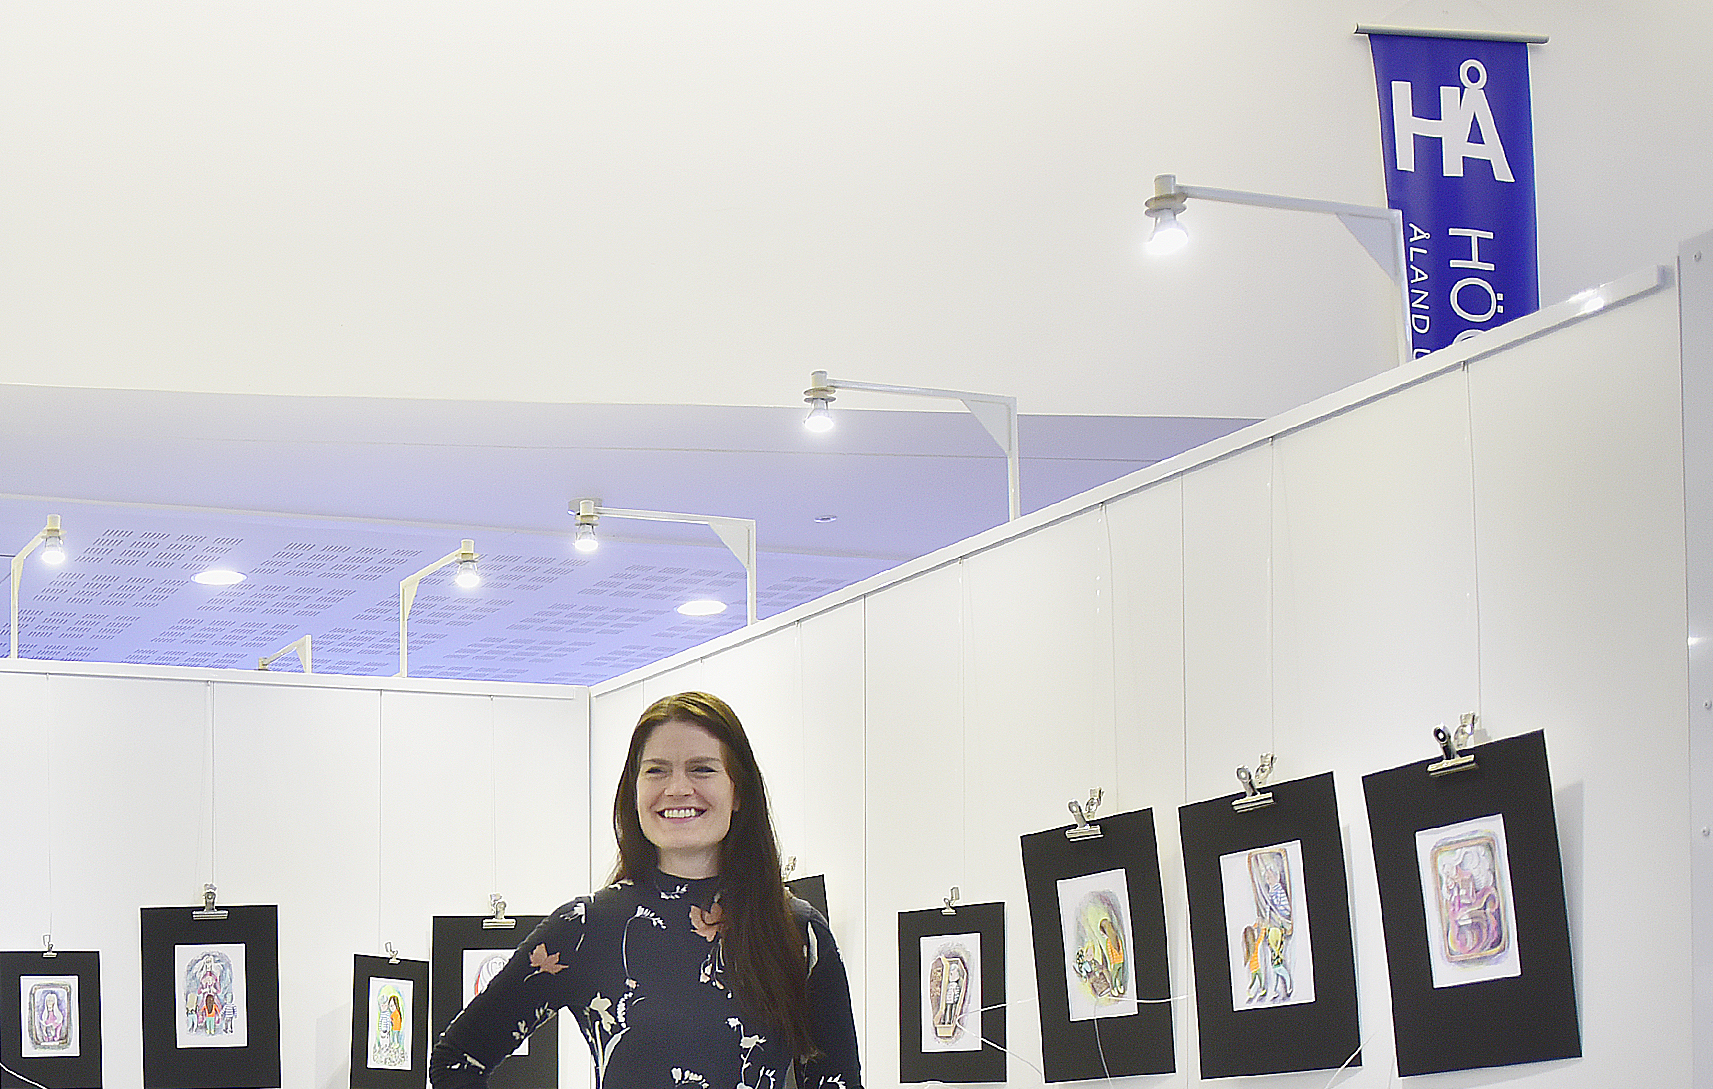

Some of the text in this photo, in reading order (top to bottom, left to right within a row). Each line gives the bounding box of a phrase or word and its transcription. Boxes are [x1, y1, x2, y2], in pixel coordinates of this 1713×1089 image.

[1391, 58, 1516, 183] HÅ
[1408, 222, 1431, 334] ÅLAND
[1448, 227, 1505, 346] HÖ
